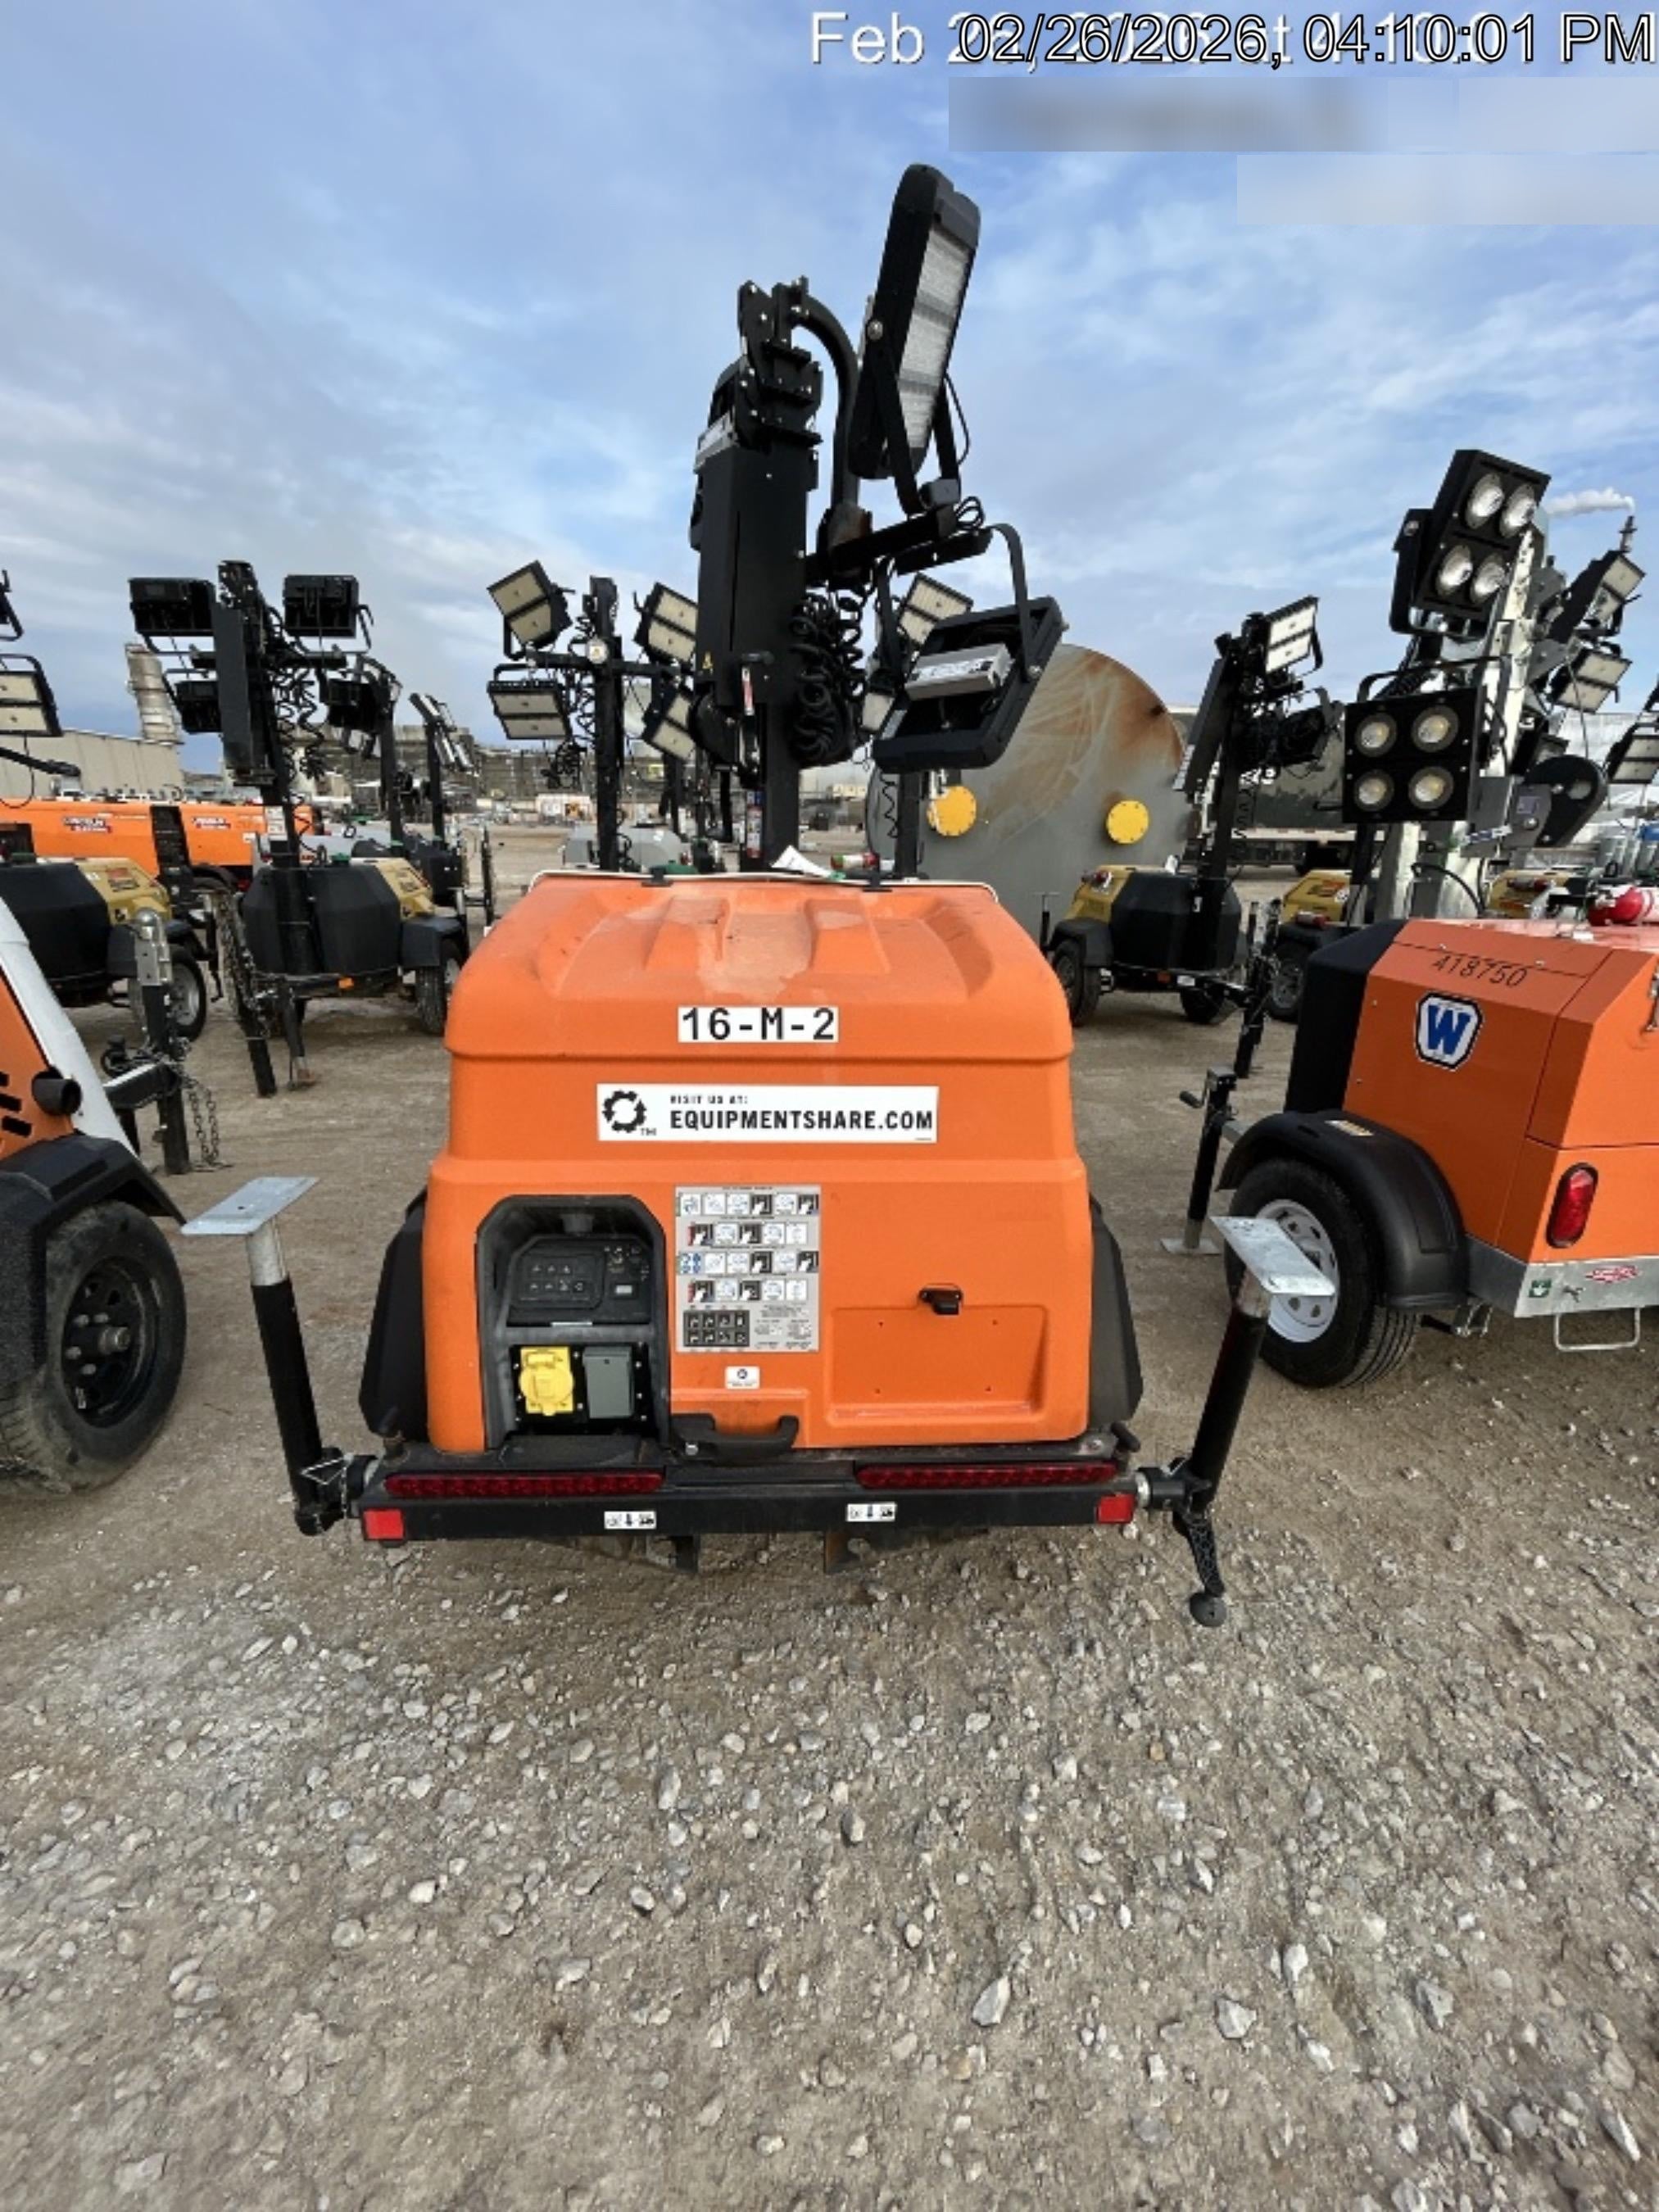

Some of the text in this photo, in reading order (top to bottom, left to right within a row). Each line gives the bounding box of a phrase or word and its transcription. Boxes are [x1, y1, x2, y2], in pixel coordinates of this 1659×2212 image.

[1431, 954, 1527, 986] 418750
[682, 1007, 835, 1041] 16-M-2
[670, 1109, 934, 1131] EQUIPMENTSHARE.COM
